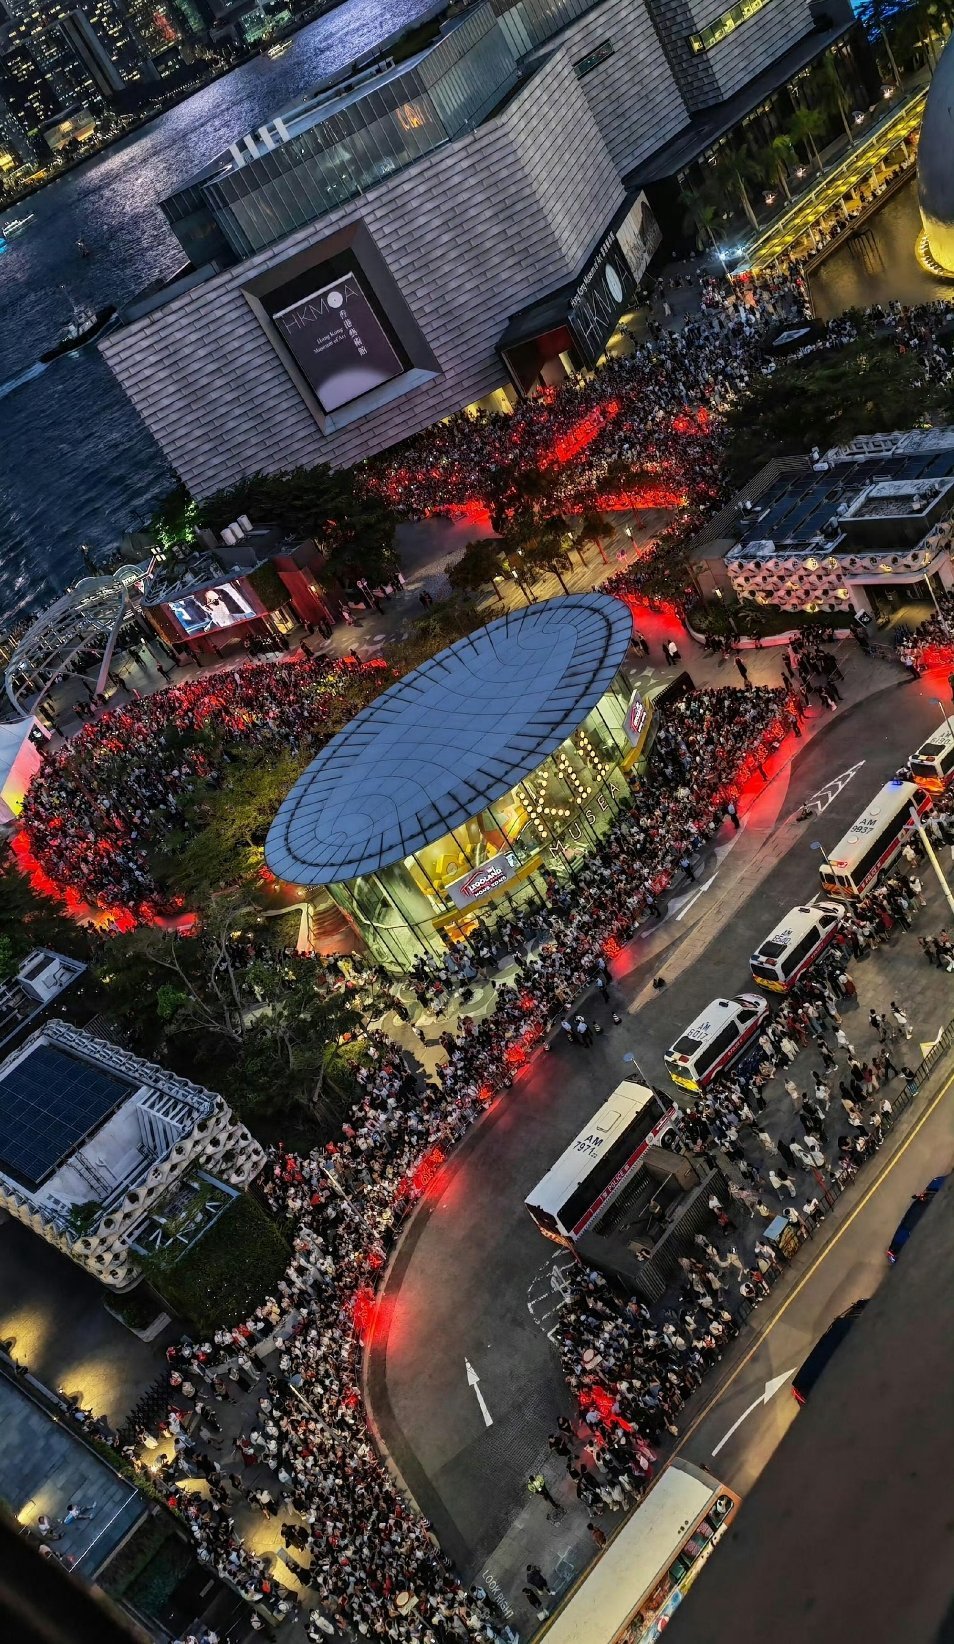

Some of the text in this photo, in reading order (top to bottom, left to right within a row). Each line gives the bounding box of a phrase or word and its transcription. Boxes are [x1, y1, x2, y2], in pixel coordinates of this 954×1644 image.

[316, 327, 343, 344] Hong Kong
[549, 782, 620, 860] MUSEA
[850, 825, 873, 834] 9937
[468, 868, 502, 891] LEGOLAND
[697, 1022, 711, 1031] AM
[572, 1140, 595, 1155] 7971
[583, 1134, 603, 1146] AM
[607, 1171, 624, 1191] POLICE
[482, 1569, 514, 1618] LOOK RIGHT
